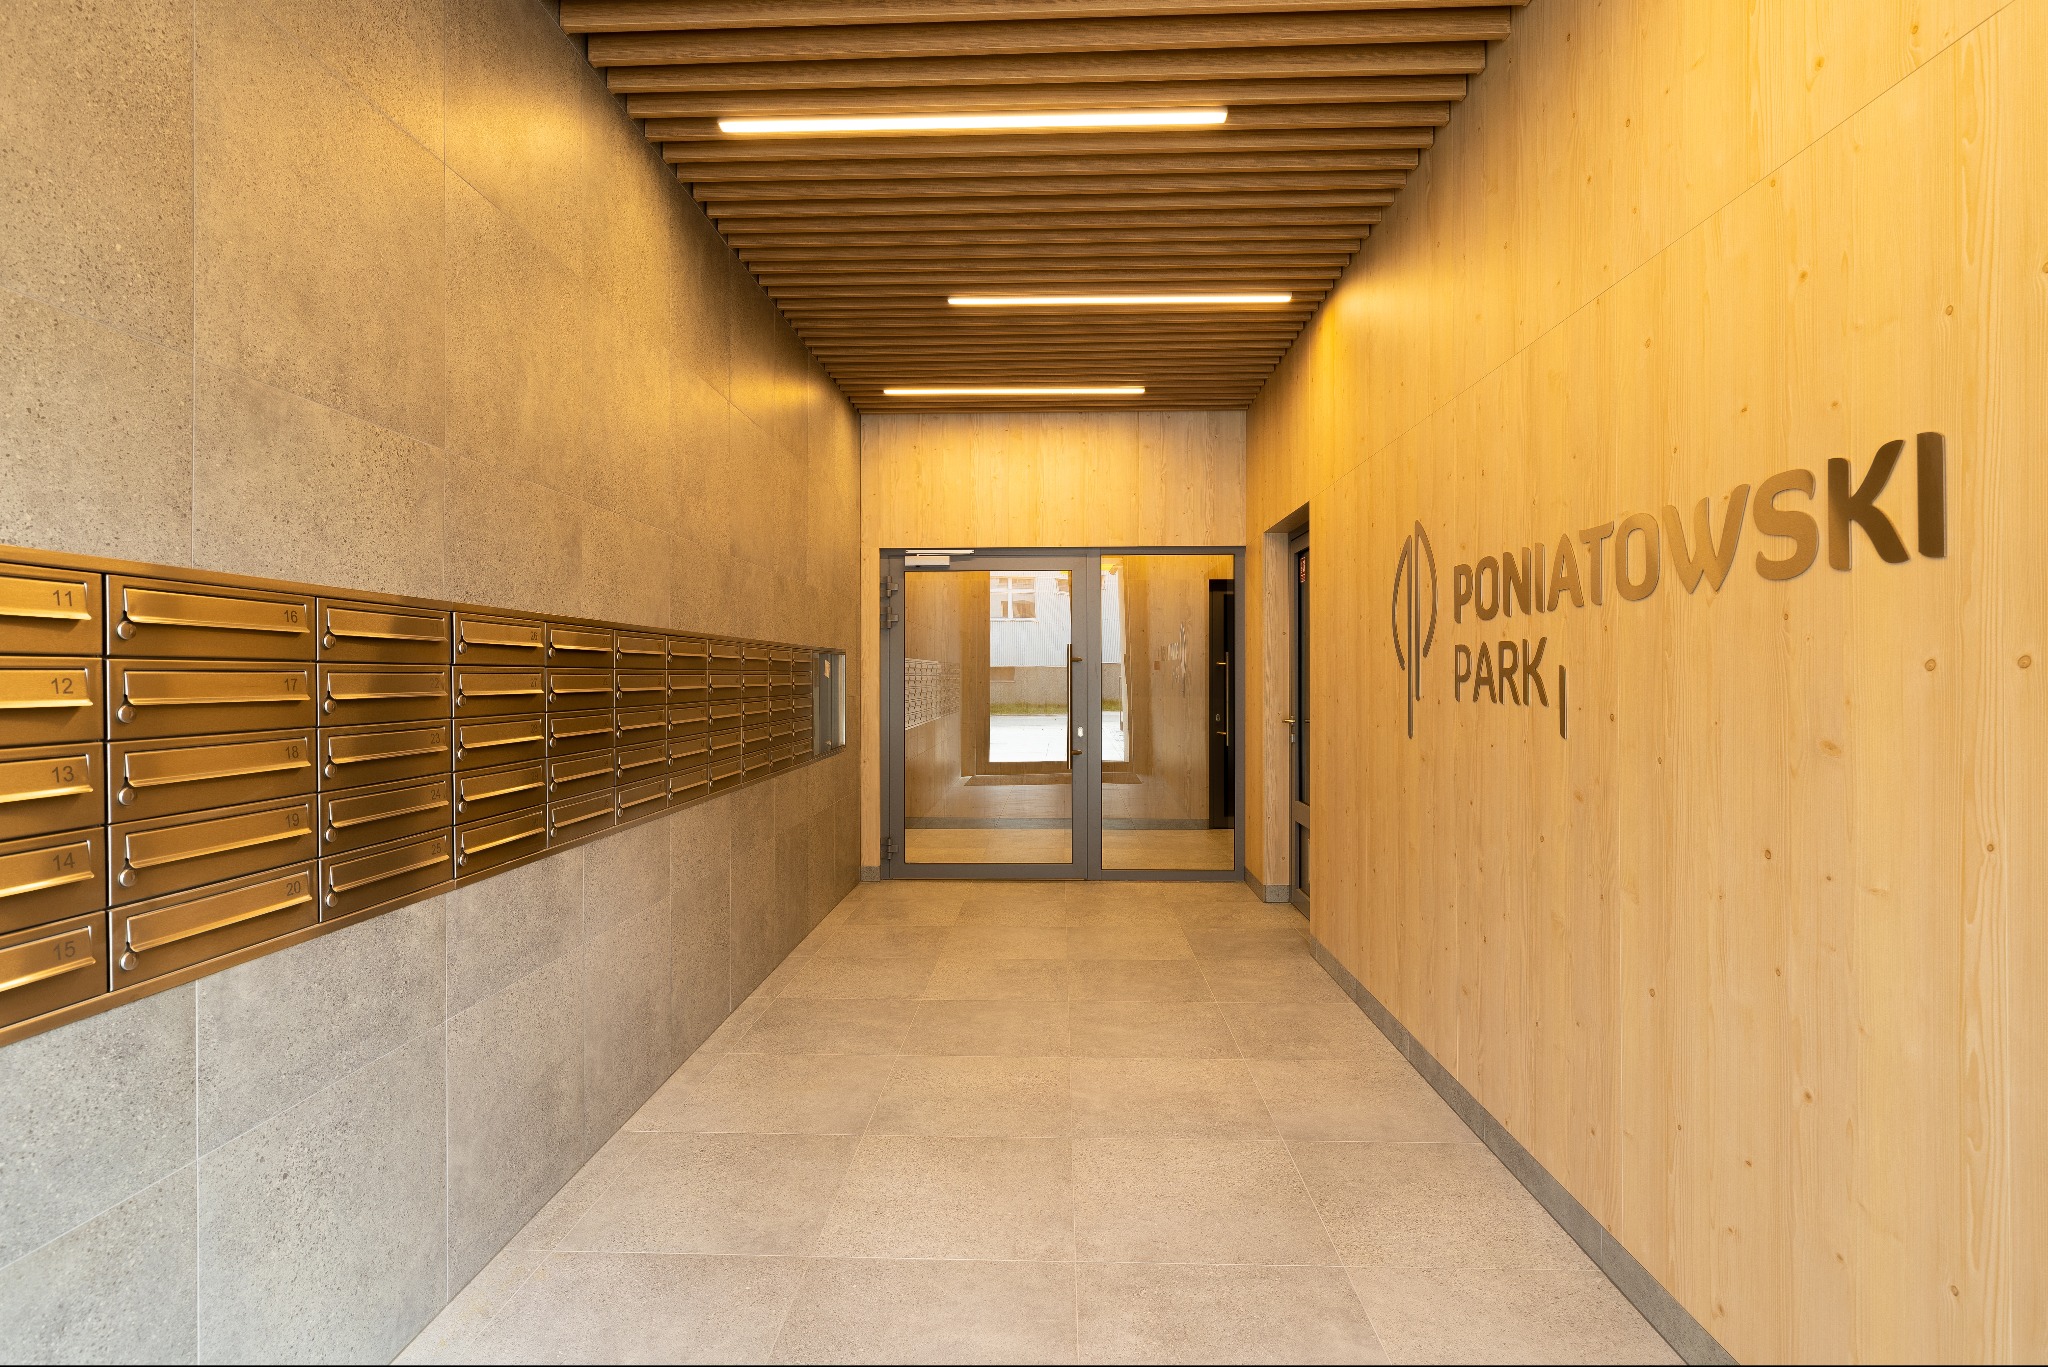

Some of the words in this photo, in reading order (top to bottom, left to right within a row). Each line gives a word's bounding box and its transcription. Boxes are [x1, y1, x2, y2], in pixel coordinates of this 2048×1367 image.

[1454, 432, 1946, 623] PONIATOWSKI
[53, 589, 73, 607] 11
[284, 610, 298, 623] 16
[531, 631, 538, 640] 26
[1455, 637, 1549, 706] PARK
[51, 678, 74, 695] 12
[284, 678, 298, 691] 17
[431, 678, 439, 688] 22
[431, 733, 440, 744] 23
[285, 746, 299, 759] 18
[52, 766, 75, 783] 13
[431, 789, 441, 800] 24
[286, 813, 300, 828] 19
[432, 843, 441, 855] 25
[53, 852, 75, 871] 14
[286, 881, 301, 896] 20
[53, 941, 76, 961] 15
